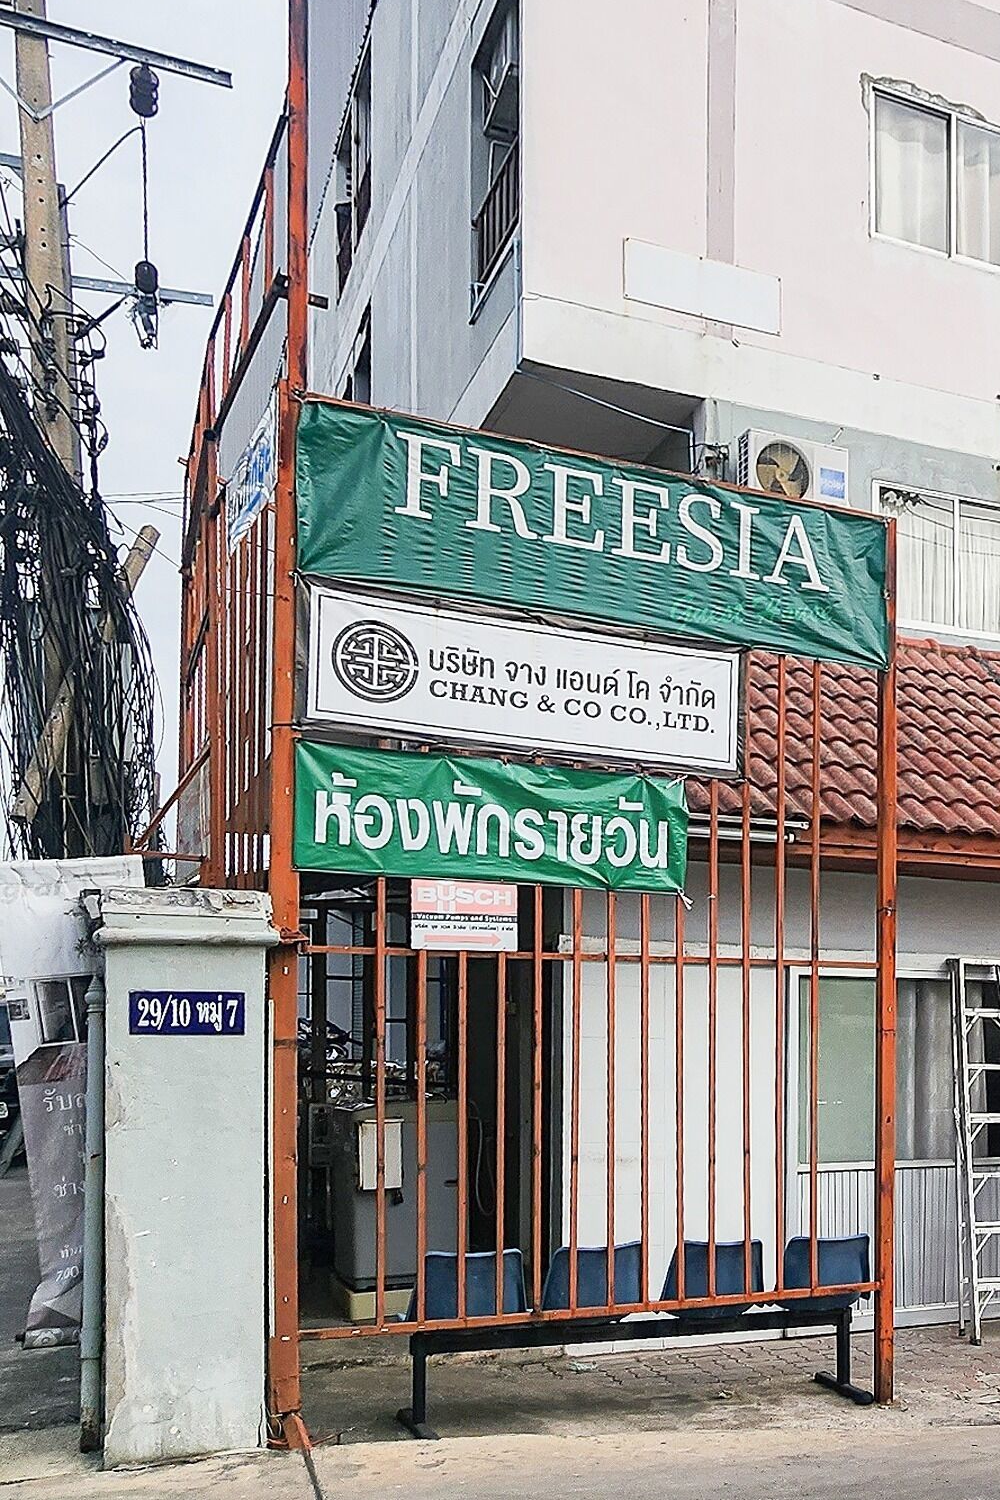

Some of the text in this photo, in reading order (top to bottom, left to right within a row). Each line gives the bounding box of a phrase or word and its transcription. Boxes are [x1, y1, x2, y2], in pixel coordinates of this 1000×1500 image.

[395, 431, 830, 592] FREESIA
[429, 646, 716, 710] บริษัท จาง แอนด์ โค จำกัด
[429, 679, 529, 709] CHANG
[537, 694, 556, 714] &
[564, 698, 601, 718] CO
[314, 772, 669, 870] ห้องพักรายวัน
[417, 882, 513, 912] BUSCH
[137, 994, 239, 1032] 29/10 หมู่ 7
